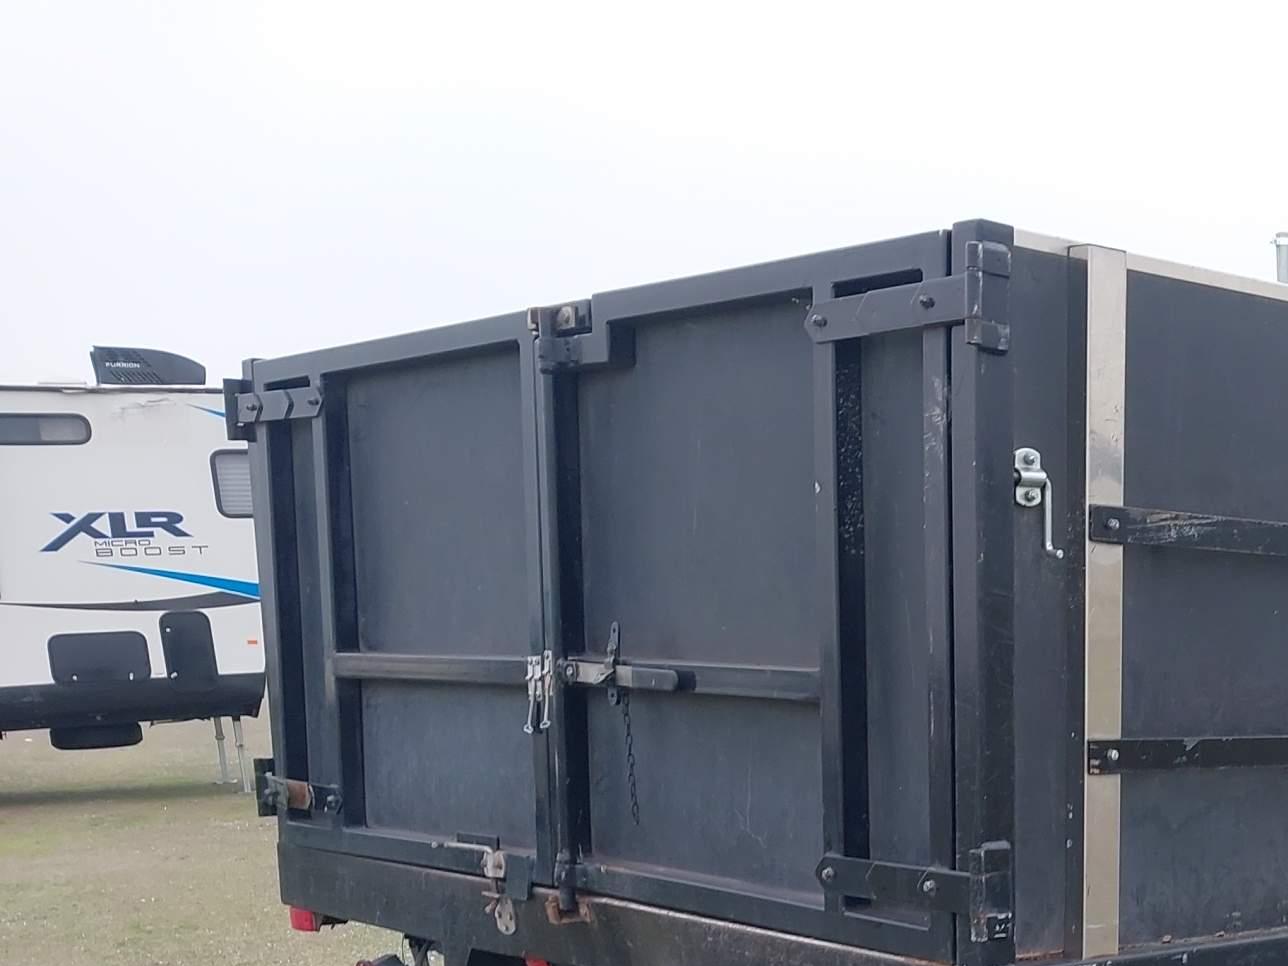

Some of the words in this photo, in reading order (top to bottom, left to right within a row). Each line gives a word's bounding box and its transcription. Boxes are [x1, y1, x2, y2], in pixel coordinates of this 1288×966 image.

[39, 512, 194, 552] XLR
[94, 539, 151, 547] MICRO
[95, 545, 208, 558] BOOST
